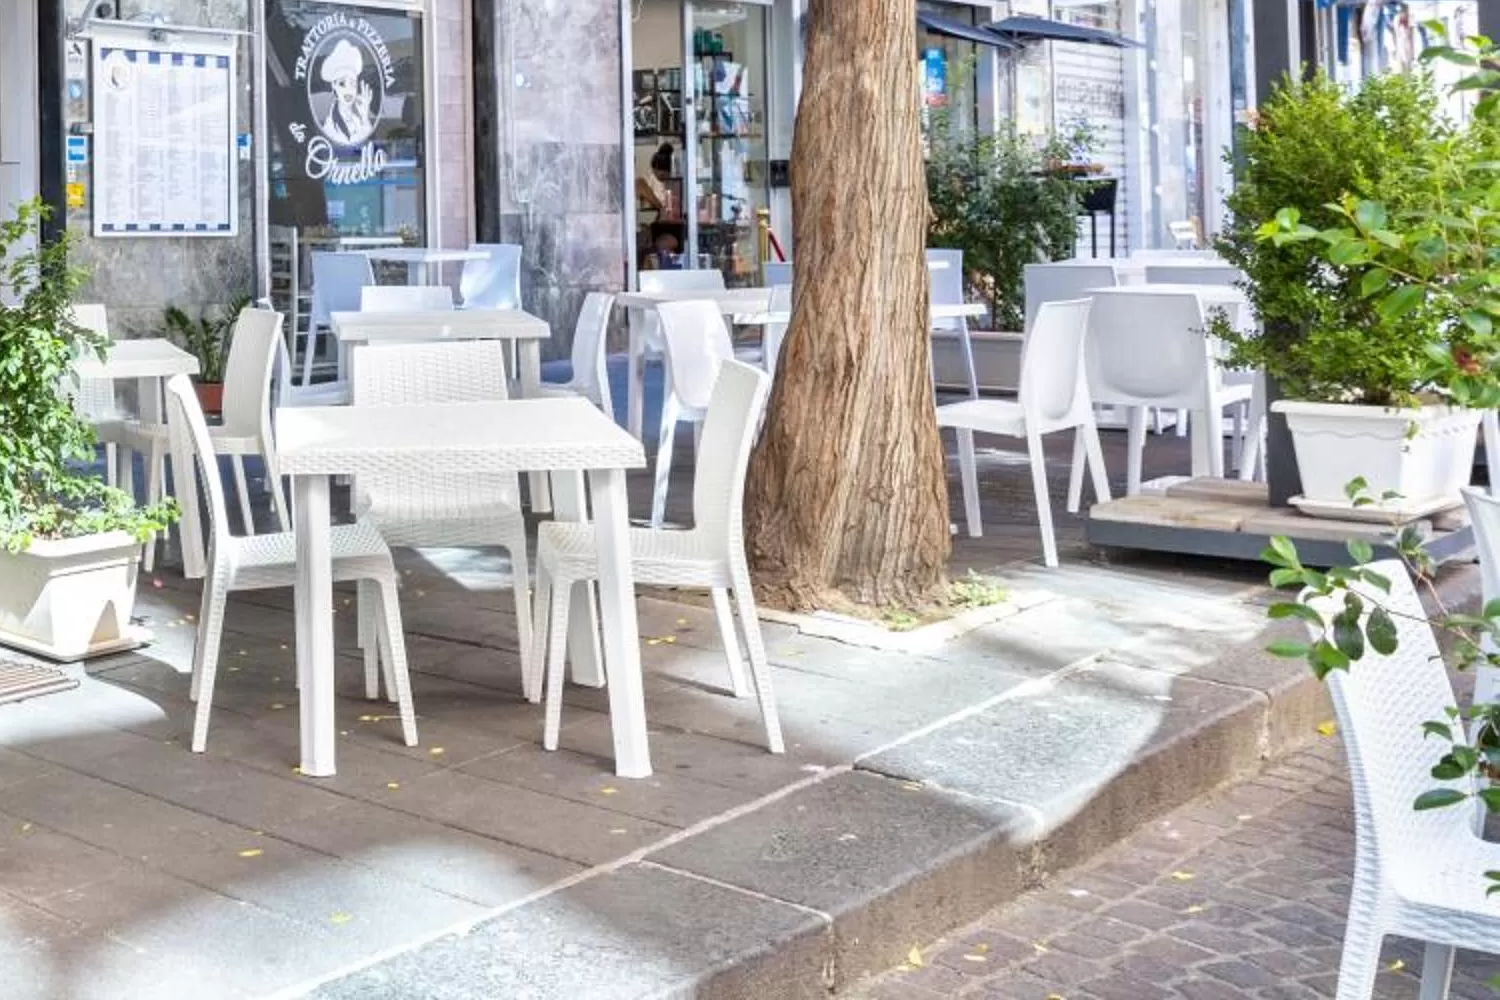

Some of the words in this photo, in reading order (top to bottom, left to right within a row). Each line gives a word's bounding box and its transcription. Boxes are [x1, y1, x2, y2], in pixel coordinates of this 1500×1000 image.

[295, 11, 347, 81] TRATTORIA
[356, 16, 397, 90] PIZZERIA
[288, 121, 308, 144] da
[304, 134, 389, 186] Ornella
